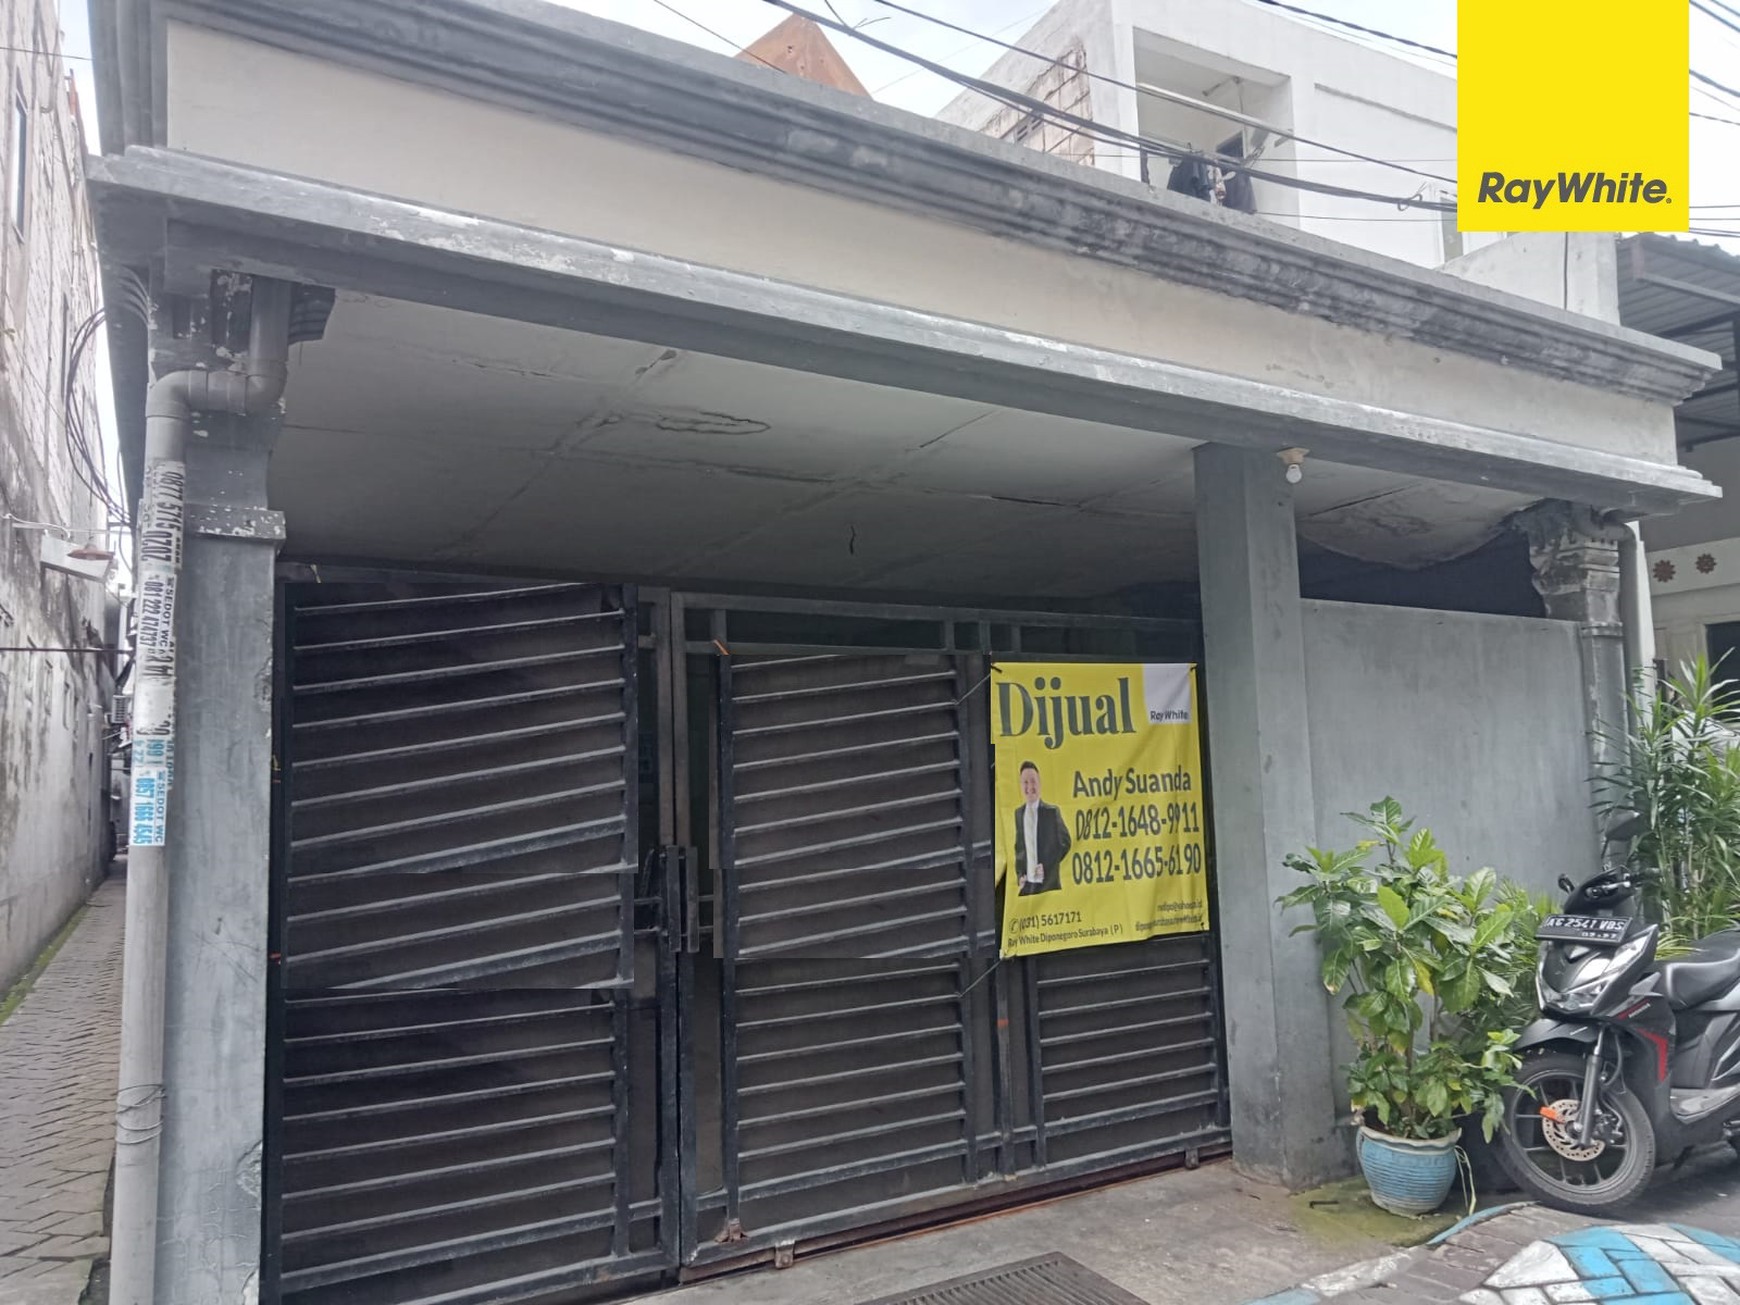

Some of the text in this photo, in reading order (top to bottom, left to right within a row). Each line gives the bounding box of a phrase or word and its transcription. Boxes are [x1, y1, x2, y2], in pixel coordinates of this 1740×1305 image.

[161, 588, 175, 627] SEDOT
[996, 677, 1136, 749] Dijual
[1073, 764, 1192, 800] Andy Suanda
[1075, 802, 1200, 841] 0812-1648-9911
[1072, 843, 1201, 885] 0812-1665-6190
